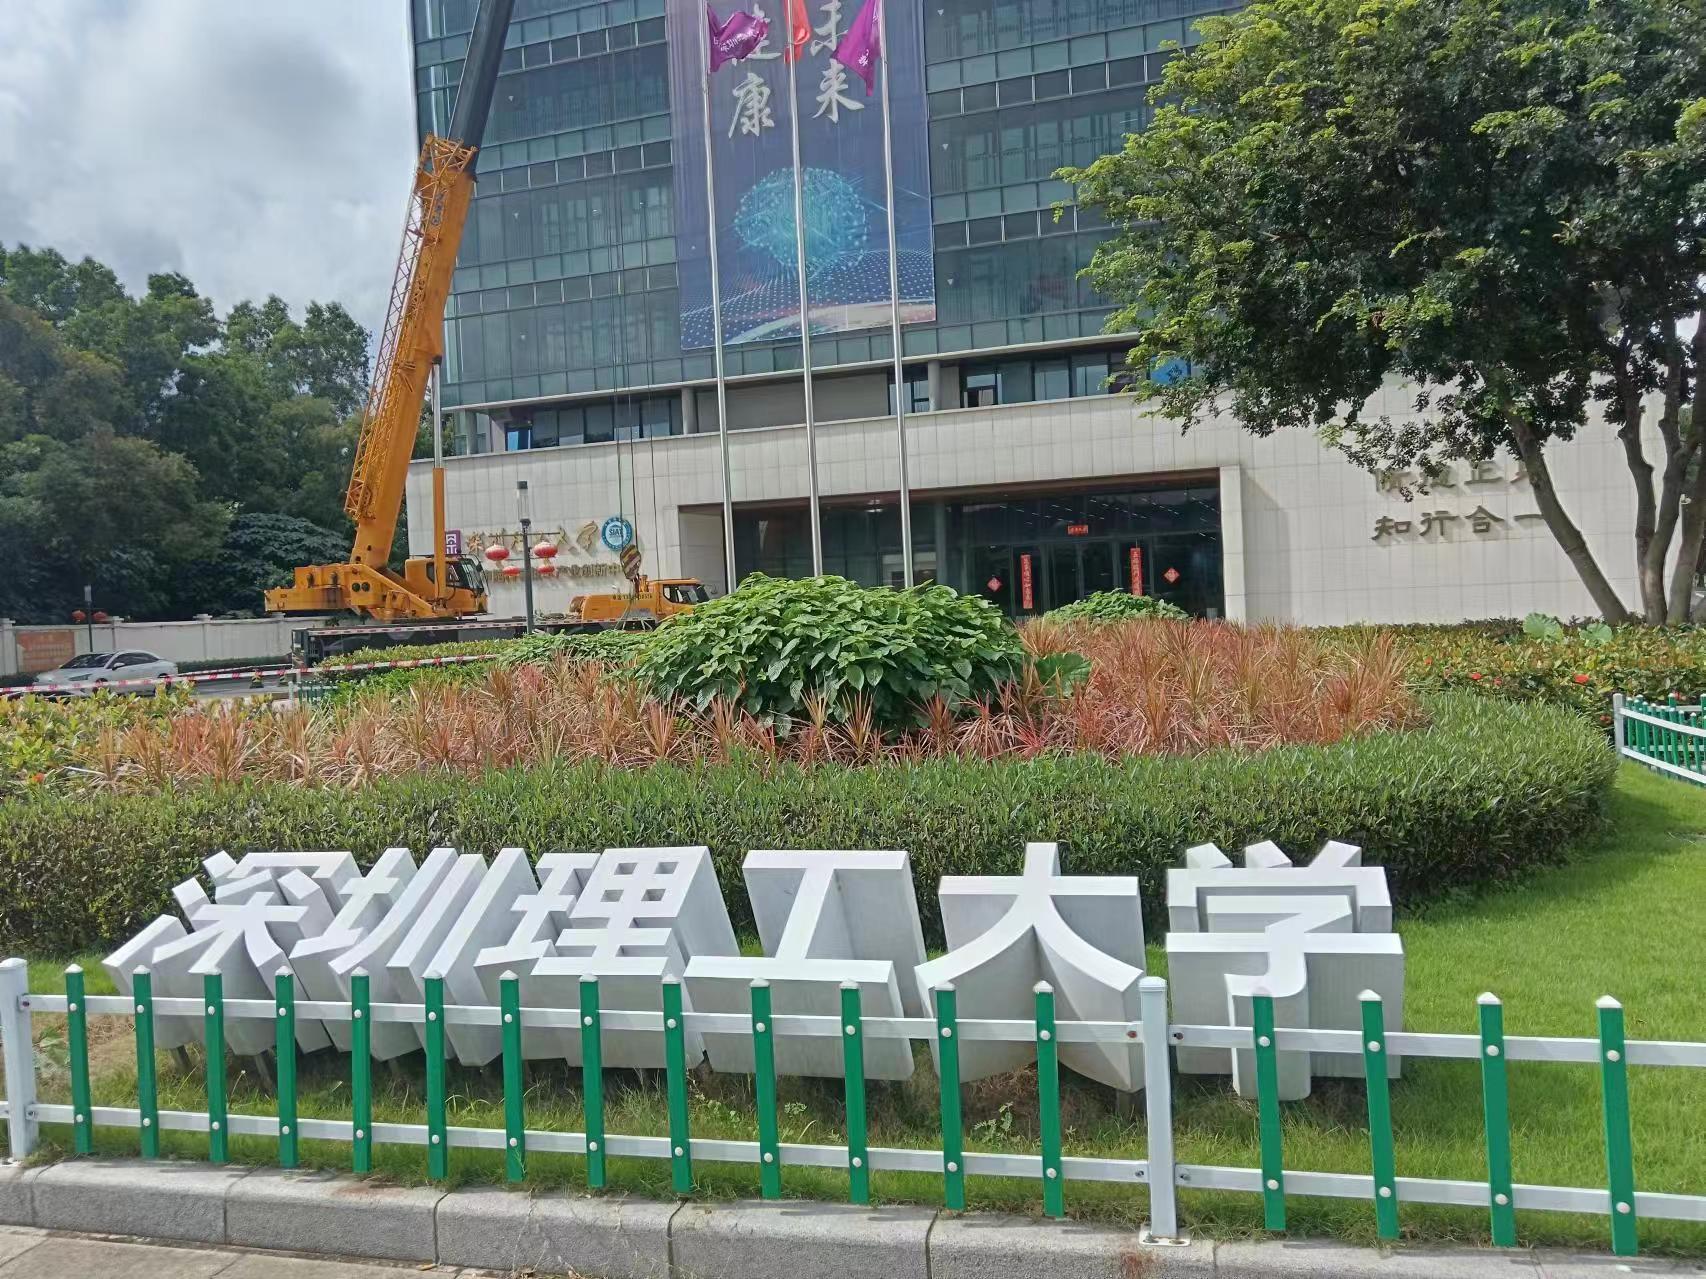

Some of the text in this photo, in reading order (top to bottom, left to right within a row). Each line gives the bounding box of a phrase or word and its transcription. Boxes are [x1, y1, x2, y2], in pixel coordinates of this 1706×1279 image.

[1371, 505, 1544, 541] 知行合一
[101, 841, 1404, 998] 深圳理工大学
